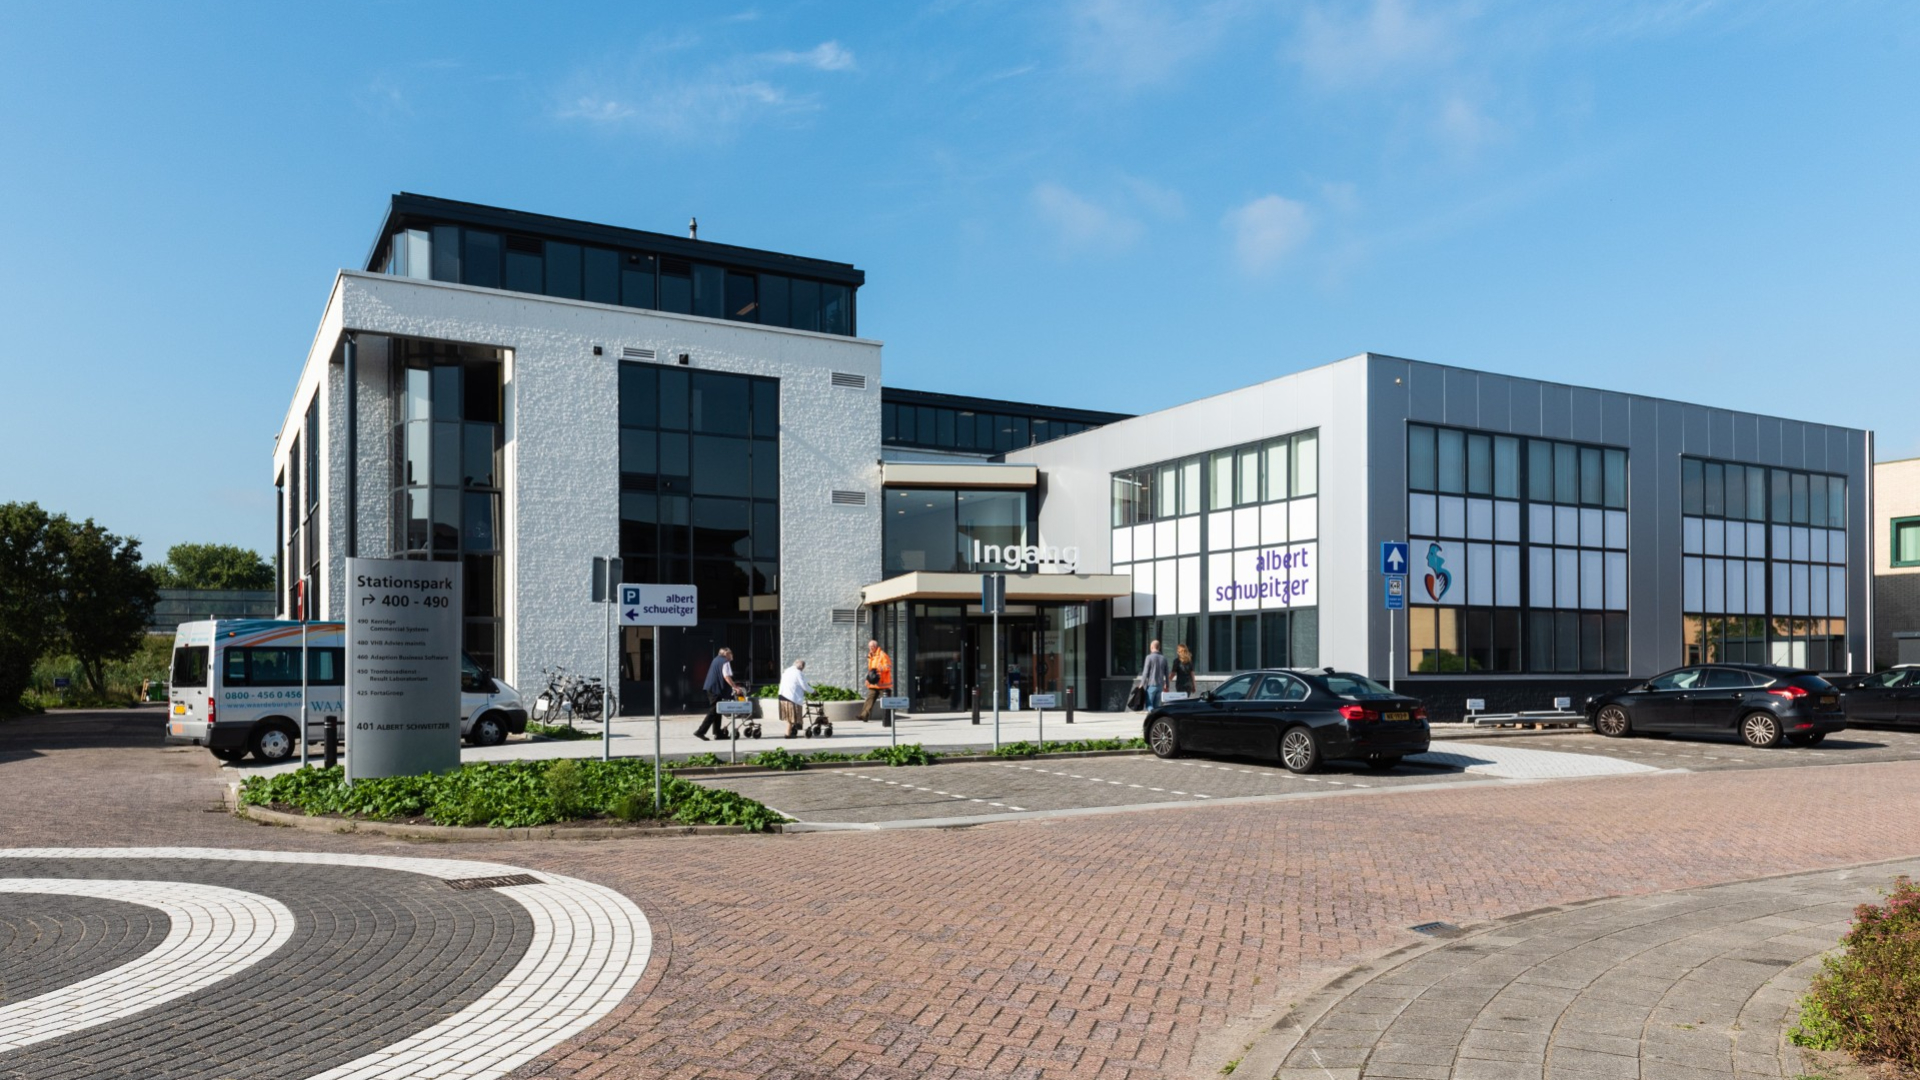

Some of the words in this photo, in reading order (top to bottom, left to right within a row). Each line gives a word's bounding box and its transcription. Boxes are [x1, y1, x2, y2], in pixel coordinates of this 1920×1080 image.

[974, 539, 1080, 571] Ingang
[1256, 547, 1309, 572] albert
[357, 575, 453, 592] Stationspark
[1215, 576, 1309, 604] schweitzer
[381, 595, 409, 607] 400
[423, 596, 449, 608] 490
[626, 590, 636, 603] P
[666, 594, 695, 603] albert
[643, 604, 695, 616] schweitzer
[225, 691, 250, 700] 0800
[257, 691, 275, 699] 456
[276, 691, 283, 699] 0
[285, 690, 302, 699] 456
[356, 722, 374, 731] 401
[376, 723, 404, 731] ALBERT
[406, 722, 450, 731] SCHWEITZER
